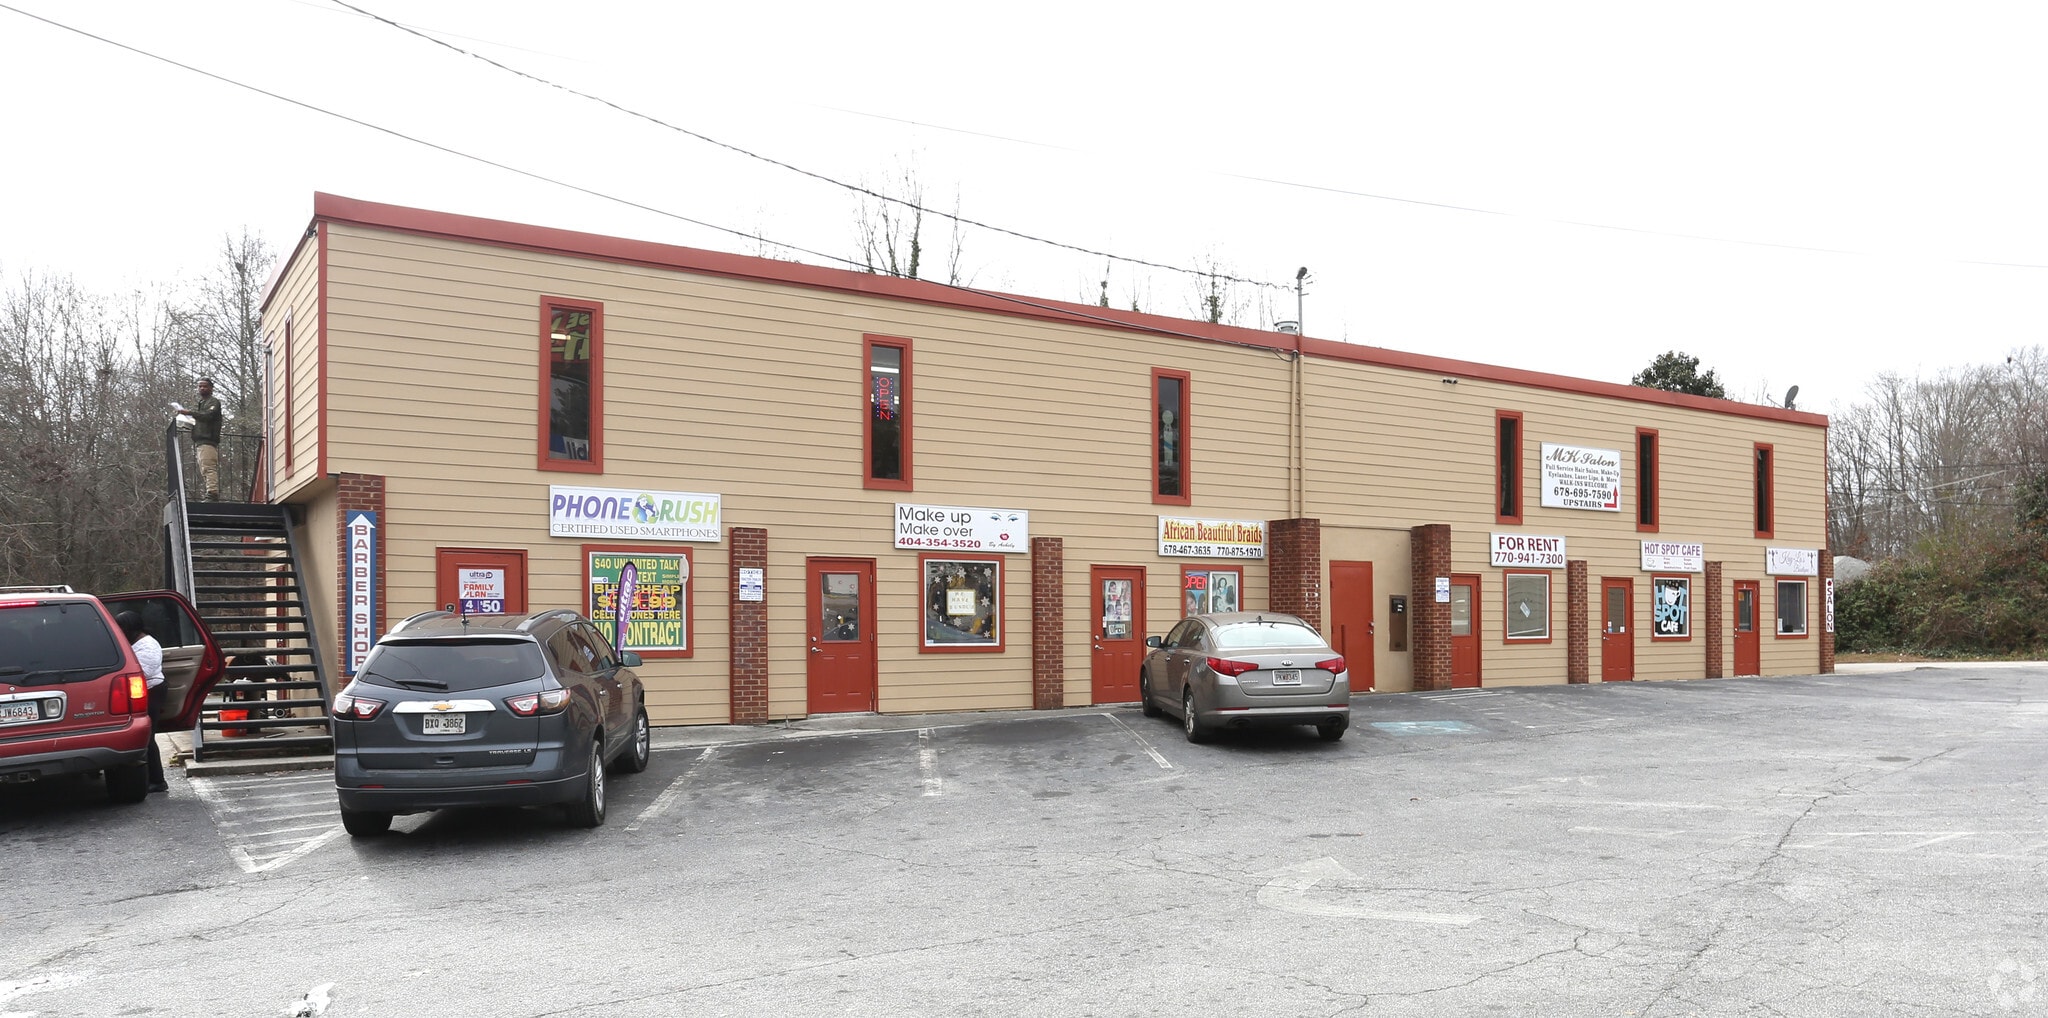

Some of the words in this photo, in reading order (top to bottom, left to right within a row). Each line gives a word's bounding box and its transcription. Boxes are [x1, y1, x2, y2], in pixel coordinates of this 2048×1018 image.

[879, 377, 890, 420] OPEN
[1546, 447, 1580, 463] MK
[1580, 452, 1617, 467] Salon
[1556, 464, 1574, 472] Service
[1601, 469, 1619, 477] Make-Up
[1559, 479, 1583, 487] WALK-INS
[1554, 486, 1612, 500] 678-695-7590
[552, 494, 633, 520] PHONE
[660, 499, 718, 524] RUSH
[1563, 499, 1602, 508] UPSTAIRS
[899, 507, 945, 522] Make
[950, 512, 971, 526] up
[552, 523, 608, 535] CERTIFIED
[609, 525, 638, 536] USED
[640, 527, 718, 538] SMARTPHONES
[900, 522, 939, 535] Make
[943, 527, 973, 537] over
[1163, 521, 1195, 541] African
[1197, 522, 1235, 542] Beautiful
[1237, 524, 1262, 543] Braids
[898, 537, 981, 548] 404-354-3520
[1498, 536, 1524, 551] FOR
[1528, 538, 1559, 551] RENT
[1163, 544, 1211, 555] 678-467-3635
[1217, 546, 1262, 557] 770-875-1970
[1644, 543, 1659, 555] HOT
[1661, 544, 1680, 555] SPOT
[1681, 545, 1700, 556] CAFE
[614, 558, 657, 569] UNMITED
[660, 560, 679, 570] TALK
[1494, 552, 1563, 564] 770-941-7300
[354, 525, 368, 606] BARBER
[637, 571, 656, 582] TEXT
[465, 600, 473, 609] 4
[1826, 587, 1834, 631] SALON
[629, 610, 654, 619] ONES
[658, 610, 680, 619] HERE
[1655, 604, 1687, 624] SPOT
[626, 621, 680, 646] ONTRACT
[0, 706, 34, 719] JW6843
[445, 718, 464, 729] 3862
